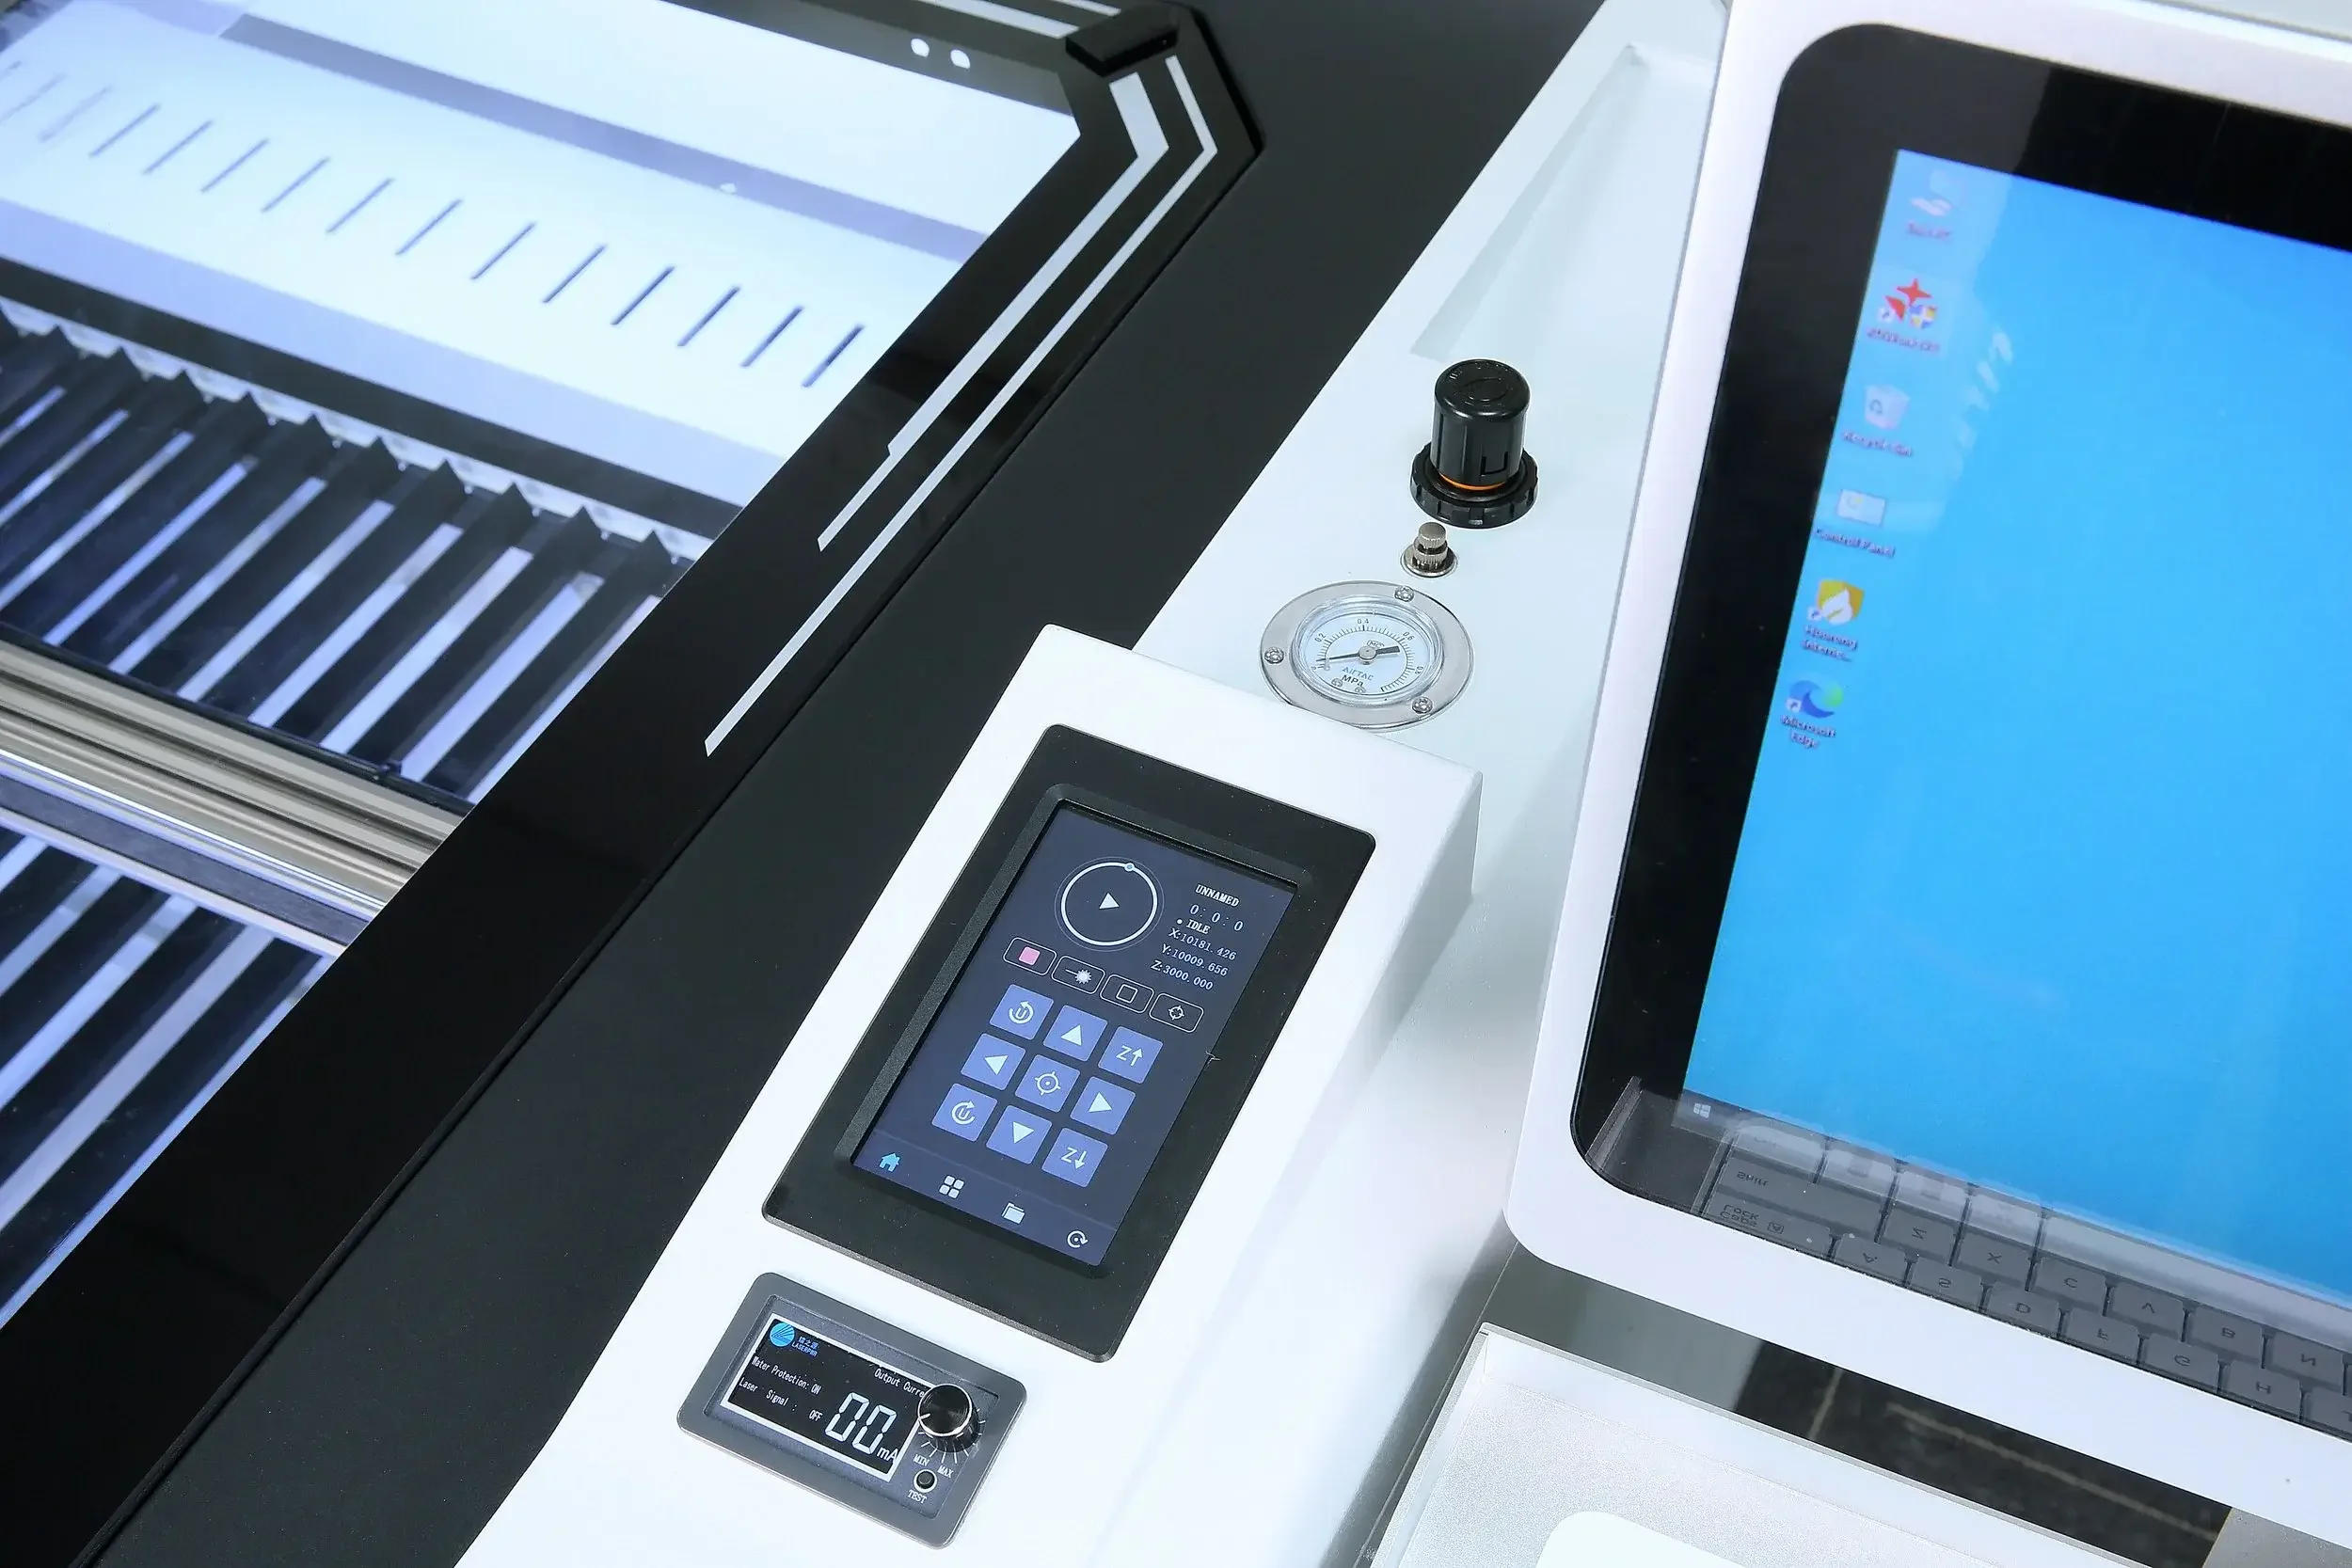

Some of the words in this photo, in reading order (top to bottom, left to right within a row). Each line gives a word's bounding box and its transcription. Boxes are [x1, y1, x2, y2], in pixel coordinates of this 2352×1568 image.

[1314, 632, 1326, 643] 0.2
[1402, 631, 1415, 641] 0.6
[1342, 674, 1365, 688] MPa
[1195, 884, 1240, 907] UNNAMED
[1185, 919, 1211, 934] IDLE
[751, 1355, 771, 1371] Water
[771, 1365, 810, 1390] Protection:
[810, 1383, 822, 1395] ON
[874, 1368, 900, 1387] Output
[903, 1381, 925, 1398] Curre
[739, 1376, 759, 1392] Laser
[766, 1389, 789, 1406] Signal
[808, 1409, 823, 1421] OFF
[876, 1447, 899, 1462] mA
[913, 1453, 930, 1466] MIN
[937, 1465, 954, 1479] MAX
[907, 1490, 928, 1504] TEST
